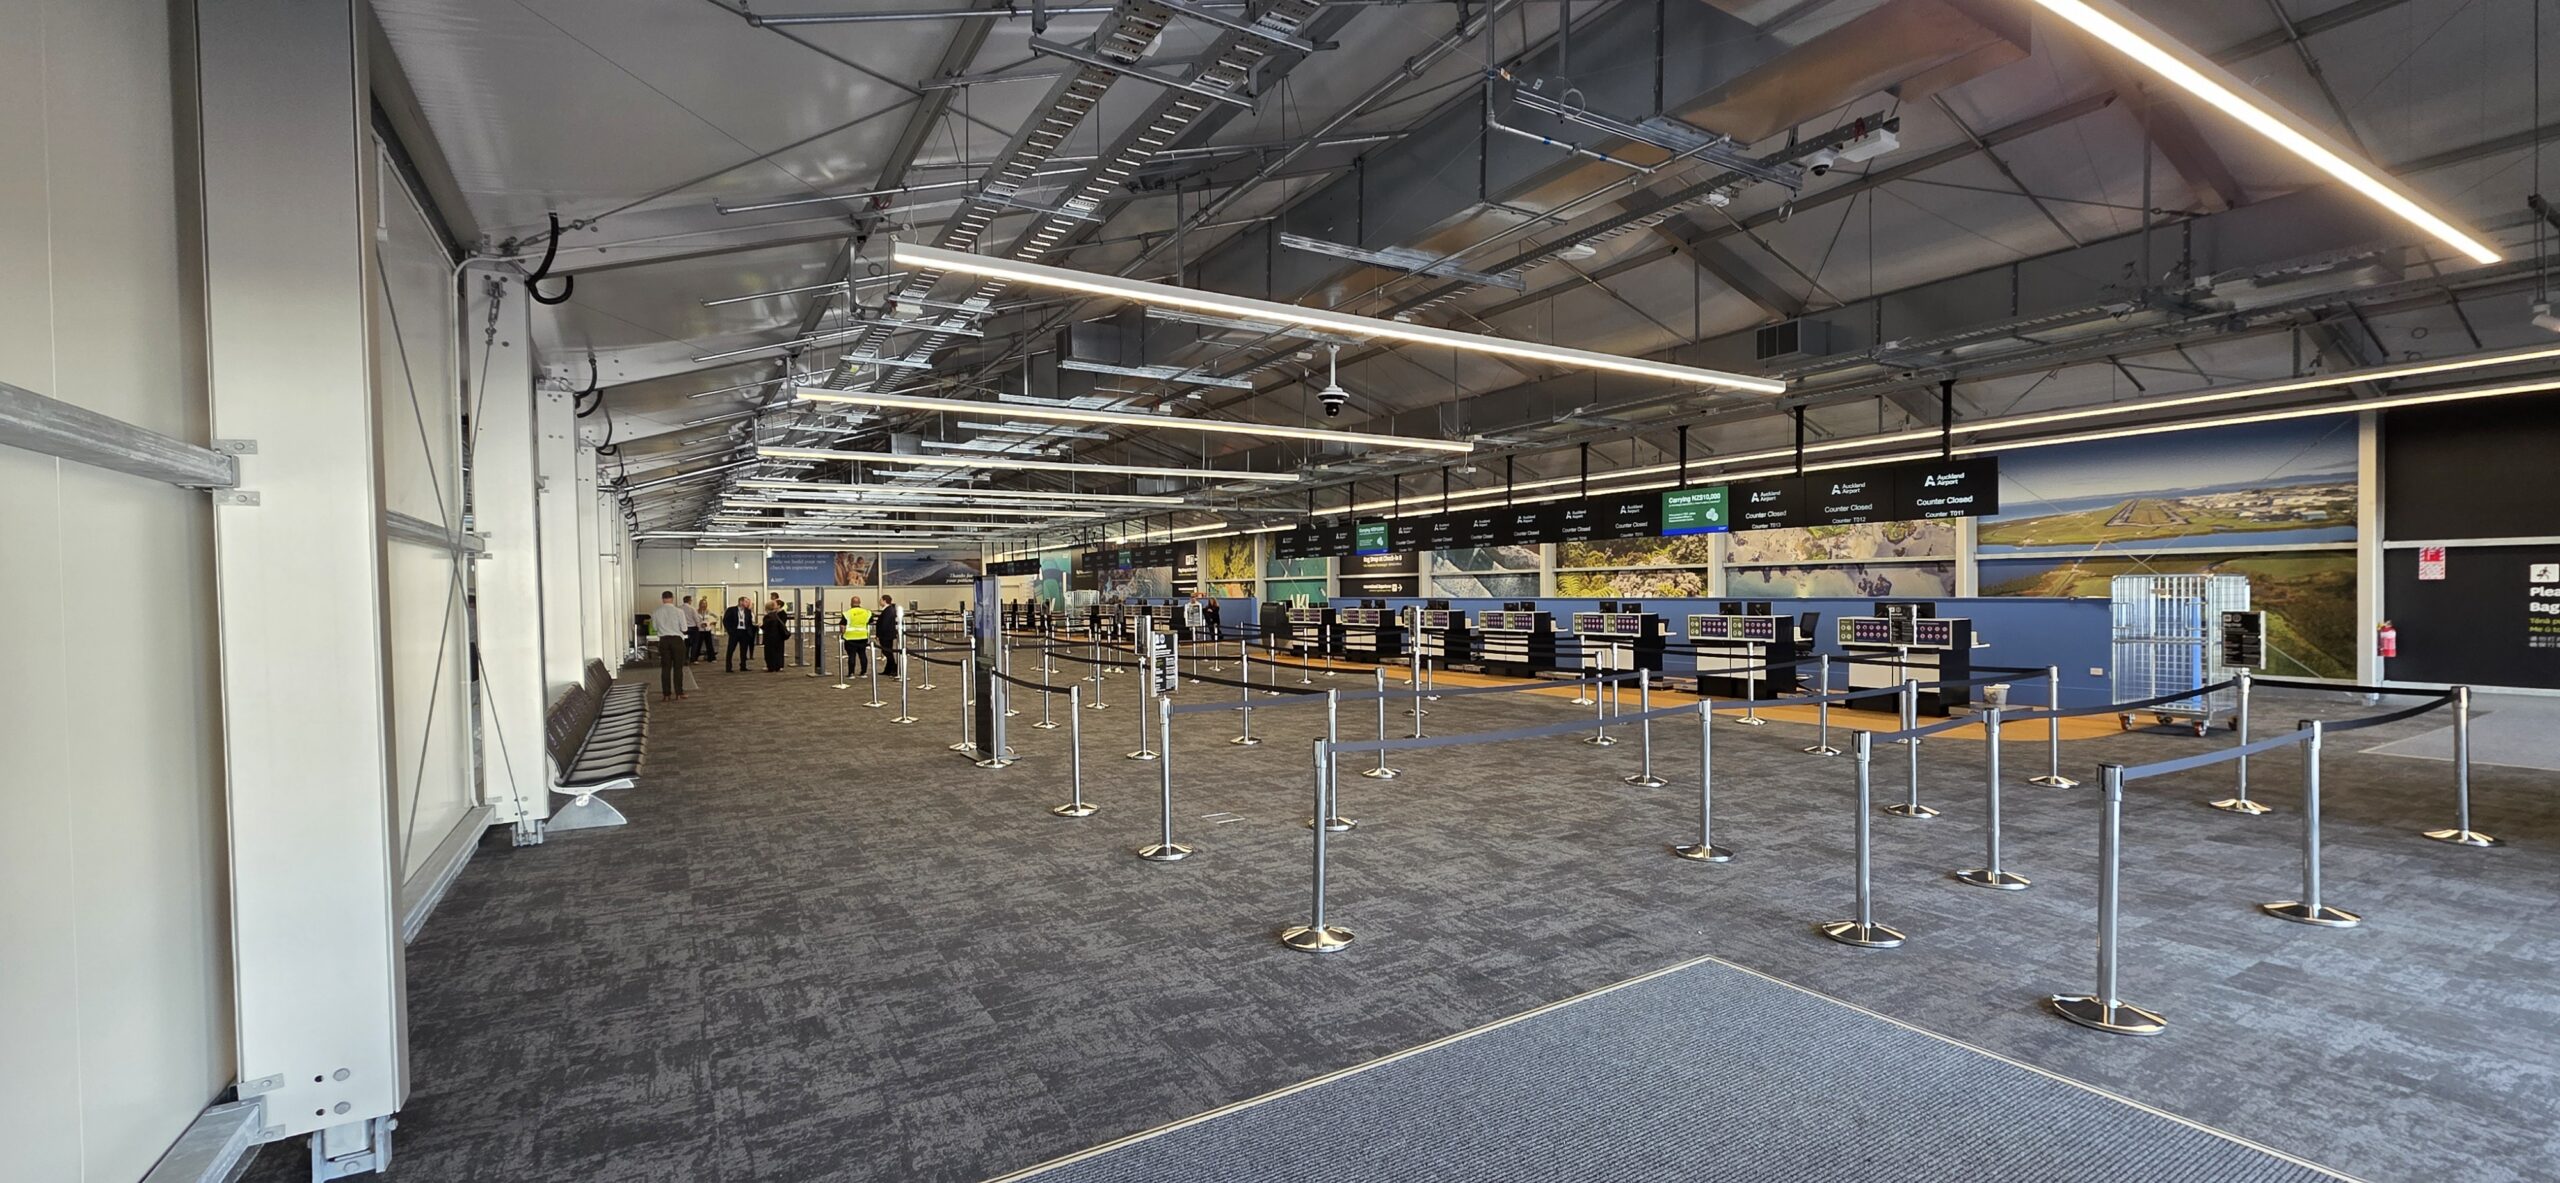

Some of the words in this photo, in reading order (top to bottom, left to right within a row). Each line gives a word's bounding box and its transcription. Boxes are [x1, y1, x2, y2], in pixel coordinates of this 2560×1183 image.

[1936, 472, 1964, 480] Auckland
[1916, 498, 1945, 506] Counter
[1946, 495, 1973, 504] Closed
[1746, 511, 1767, 519] Counter
